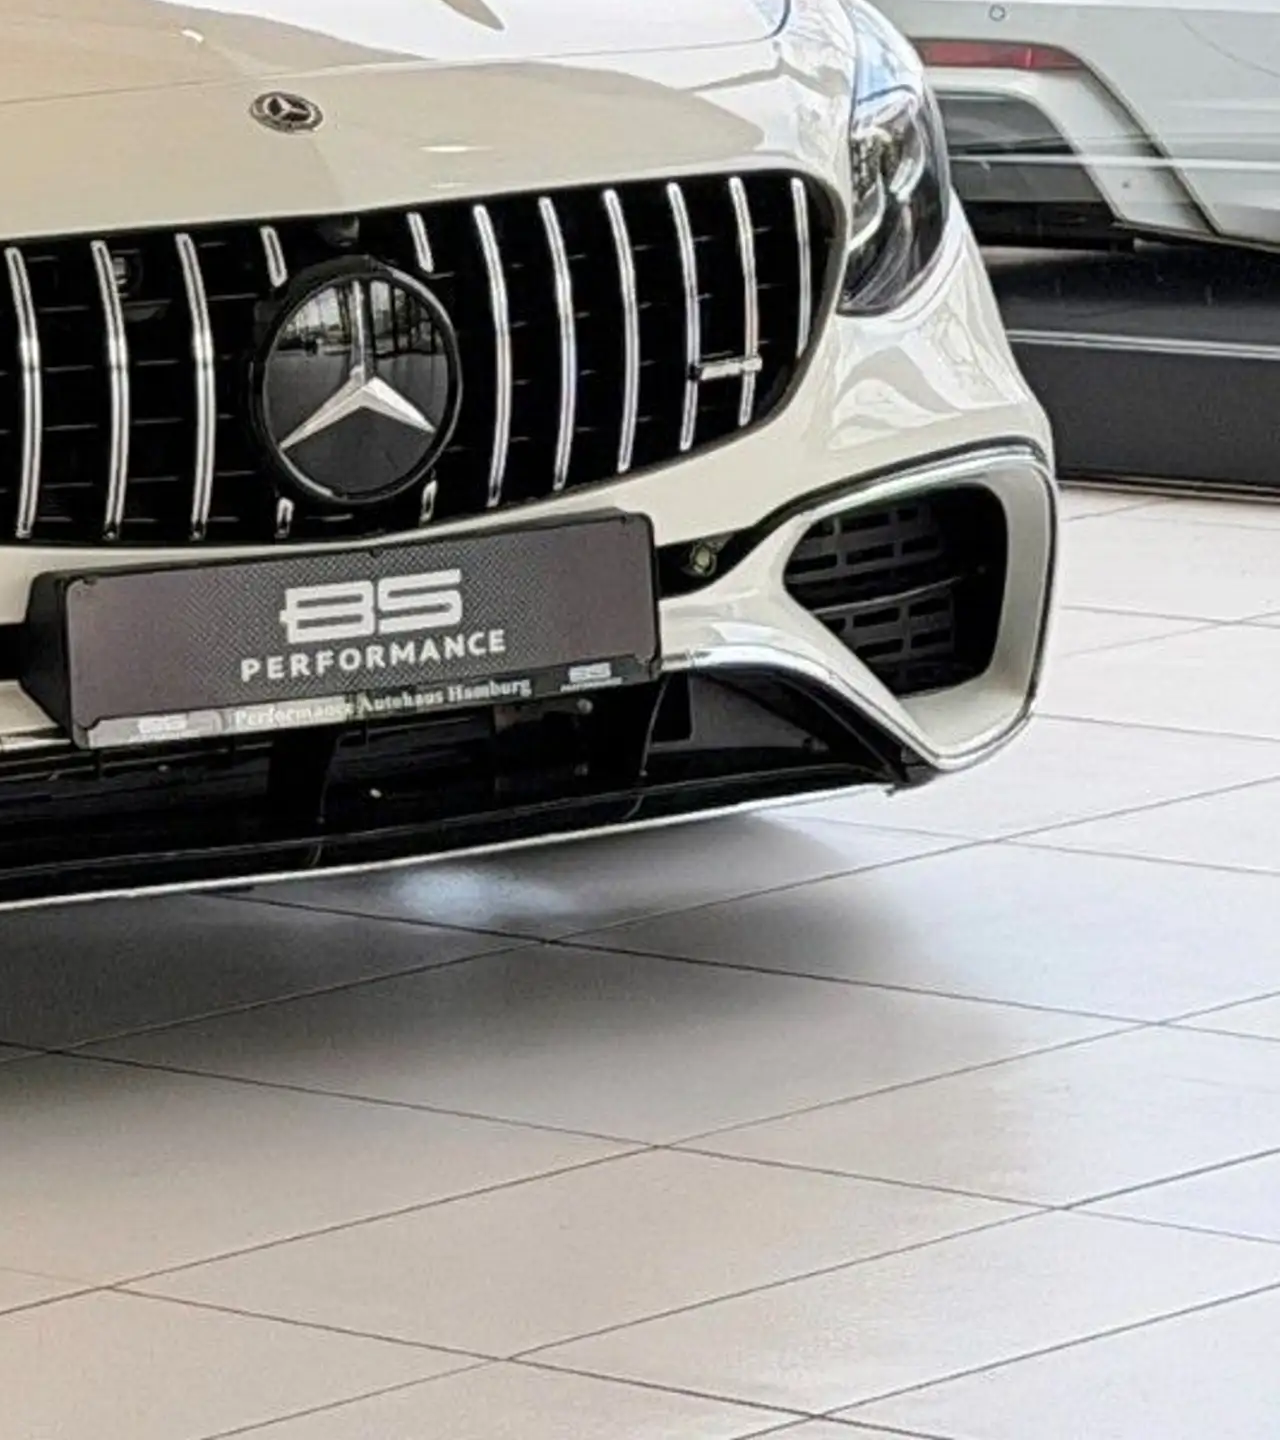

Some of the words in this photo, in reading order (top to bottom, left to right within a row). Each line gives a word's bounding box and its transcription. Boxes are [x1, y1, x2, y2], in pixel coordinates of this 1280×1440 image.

[242, 629, 507, 682] PERFORMANCE
[358, 690, 443, 716] Autohaus
[448, 678, 531, 704] Hamburg
